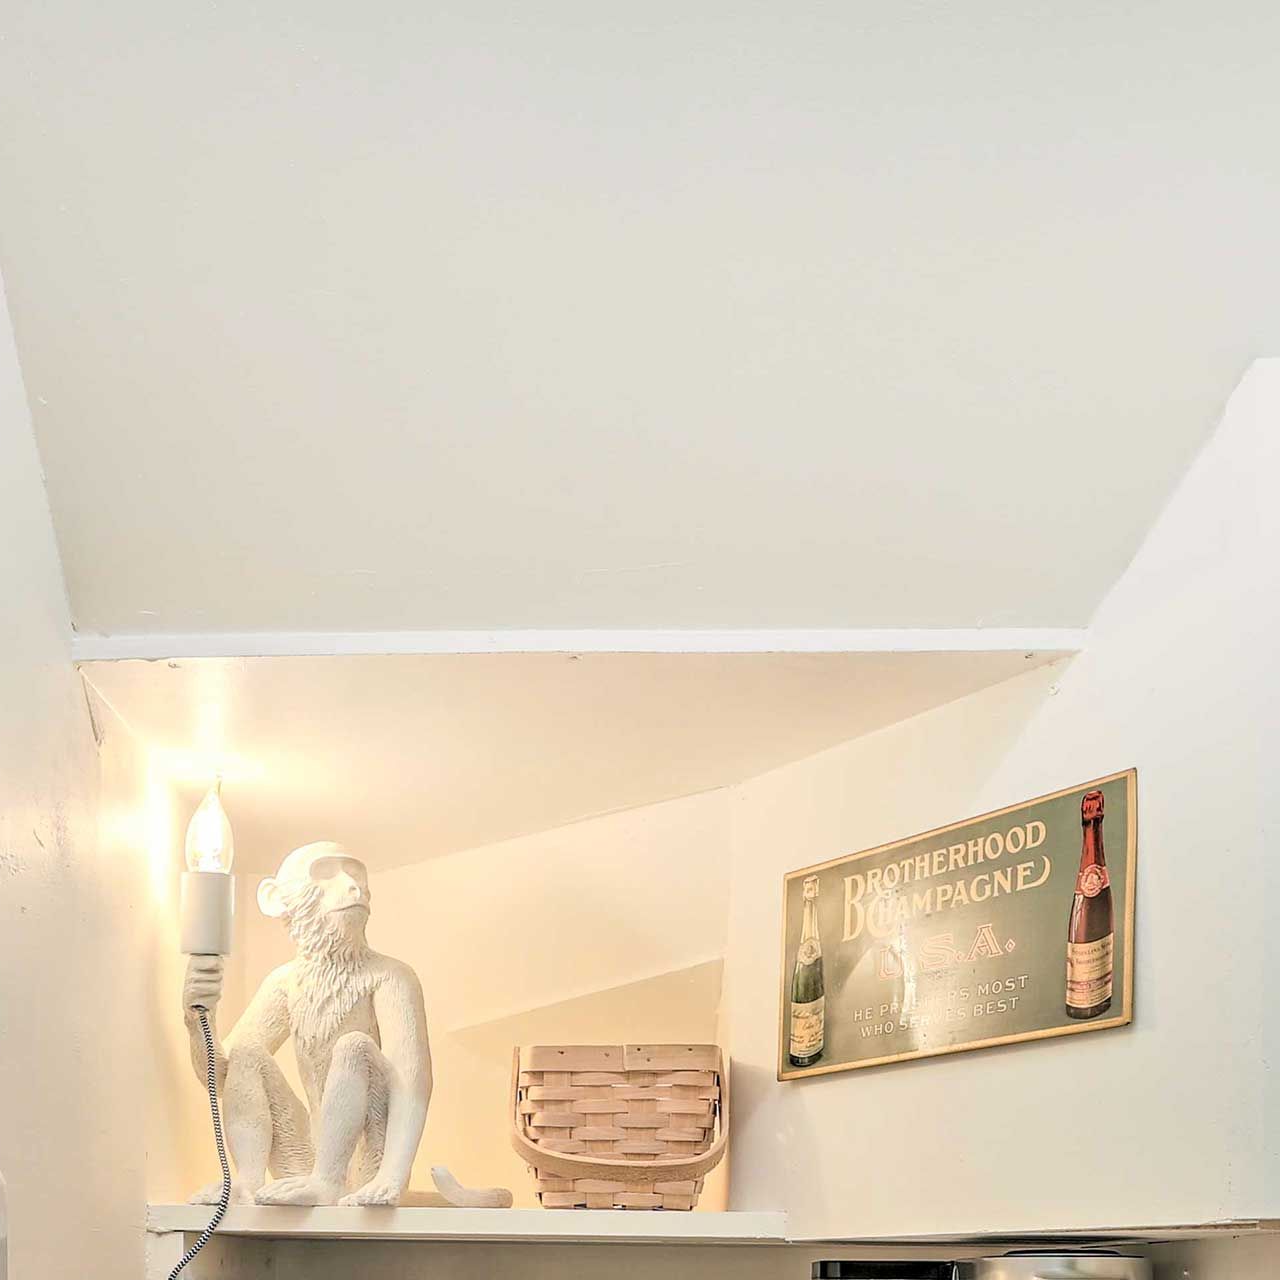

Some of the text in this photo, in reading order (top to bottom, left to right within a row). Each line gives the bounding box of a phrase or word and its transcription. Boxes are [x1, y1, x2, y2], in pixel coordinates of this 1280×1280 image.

[841, 820, 1047, 942] BROTHERHOOD
[866, 855, 1051, 939] CHAMPAGNE
[879, 923, 1016, 981] US.A.
[853, 1007, 873, 1022] HE
[978, 975, 1029, 997] MOST
[860, 1021, 894, 1039] WHO
[973, 996, 1019, 1017] BEST
